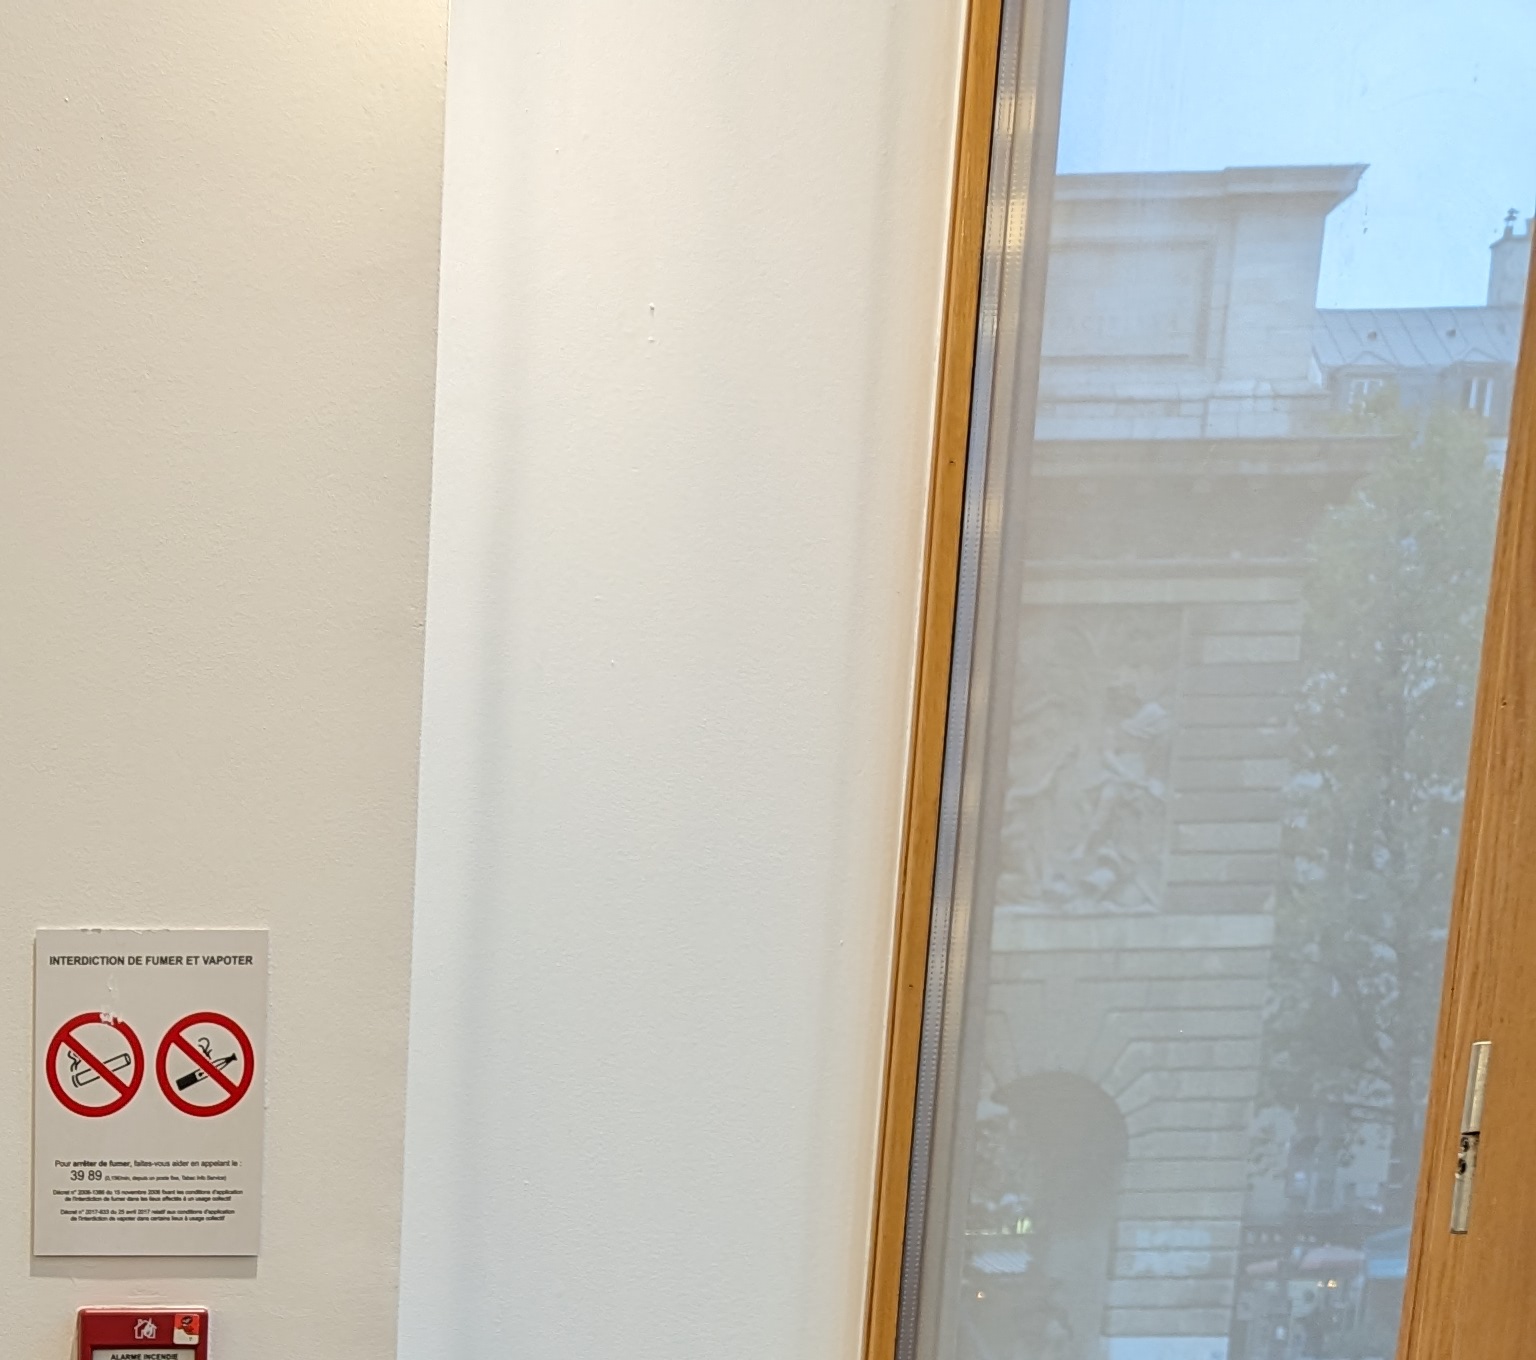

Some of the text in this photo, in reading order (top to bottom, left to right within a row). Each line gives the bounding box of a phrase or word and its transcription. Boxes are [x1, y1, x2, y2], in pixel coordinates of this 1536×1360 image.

[49, 956, 253, 966] INTERDICTION DE FUMER ET VAPOTER
[201, 1160, 230, 1168] appelant
[70, 1169, 103, 1181] 39 89
[110, 1353, 178, 1360] ALARME INCENDIE
